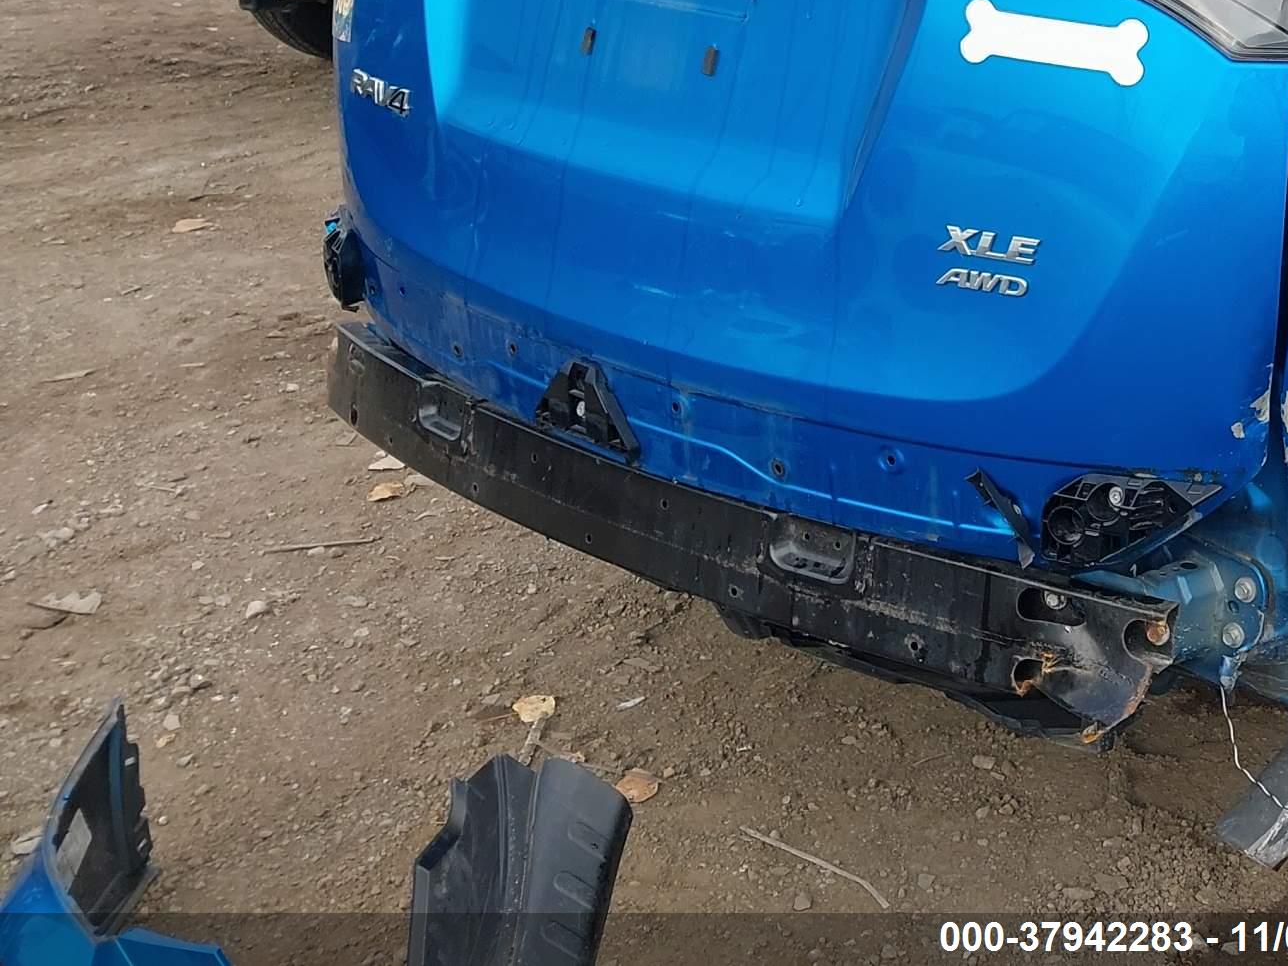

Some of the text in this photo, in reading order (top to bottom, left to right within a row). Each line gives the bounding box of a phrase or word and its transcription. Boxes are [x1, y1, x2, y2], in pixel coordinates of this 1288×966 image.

[351, 68, 414, 119] RAV4
[937, 225, 1041, 265] XLE
[936, 268, 1028, 297] AWD
